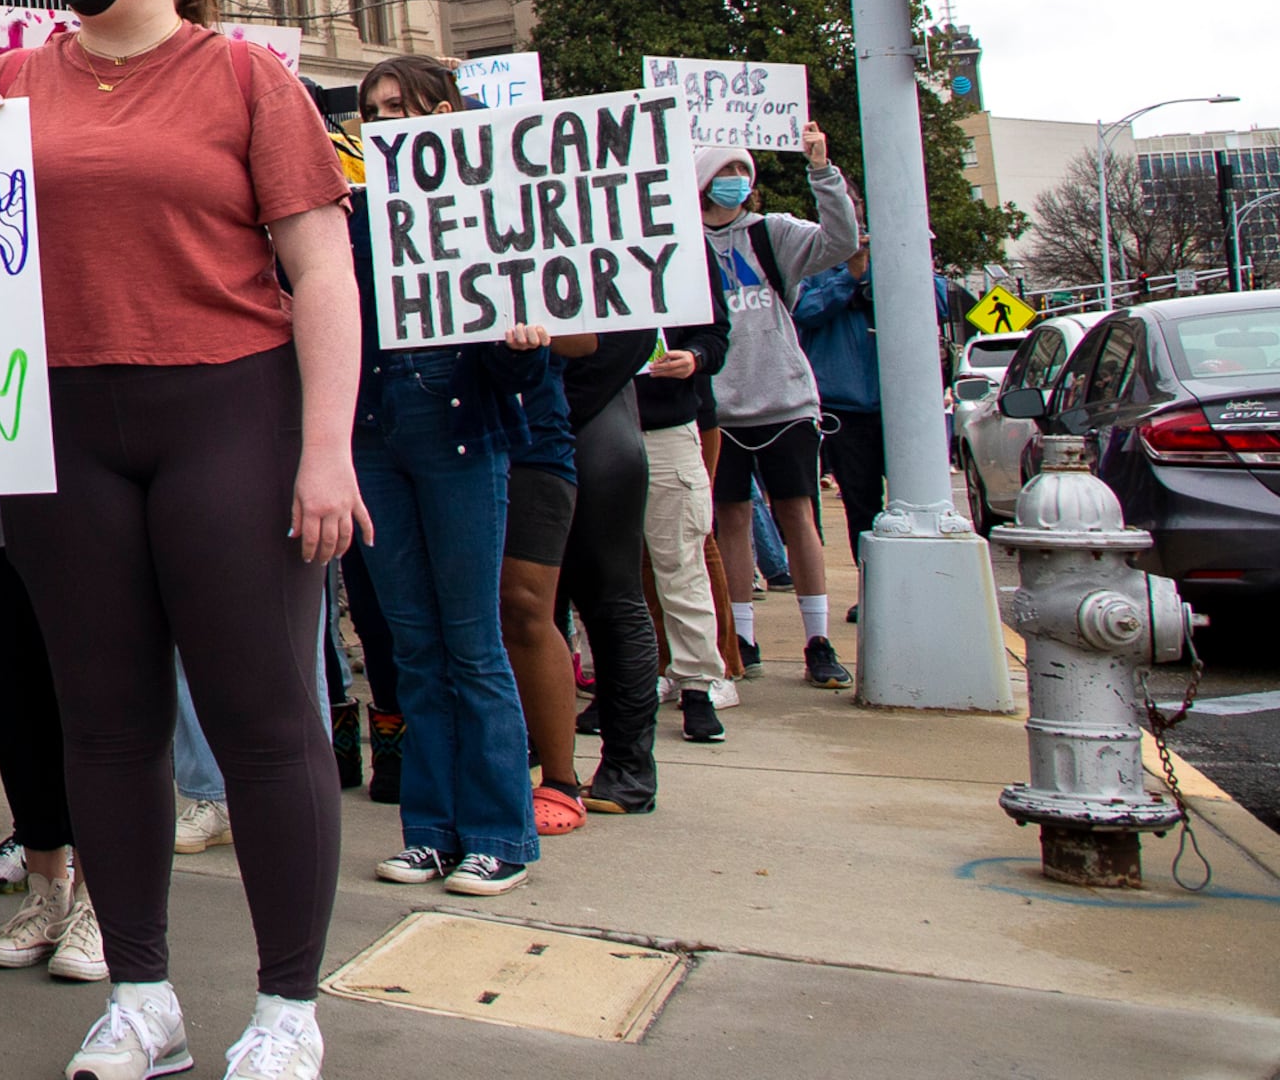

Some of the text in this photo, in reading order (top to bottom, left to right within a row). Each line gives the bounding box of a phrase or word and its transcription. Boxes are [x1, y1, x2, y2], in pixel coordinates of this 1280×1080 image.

[490, 59, 510, 74] AN
[648, 59, 769, 99] Hands
[370, 91, 677, 194] YOU CAN'T
[385, 168, 675, 268] RE-WRITE
[391, 241, 679, 341] HISTORY
[727, 286, 773, 313] das
[1220, 410, 1279, 419] CIVIC
